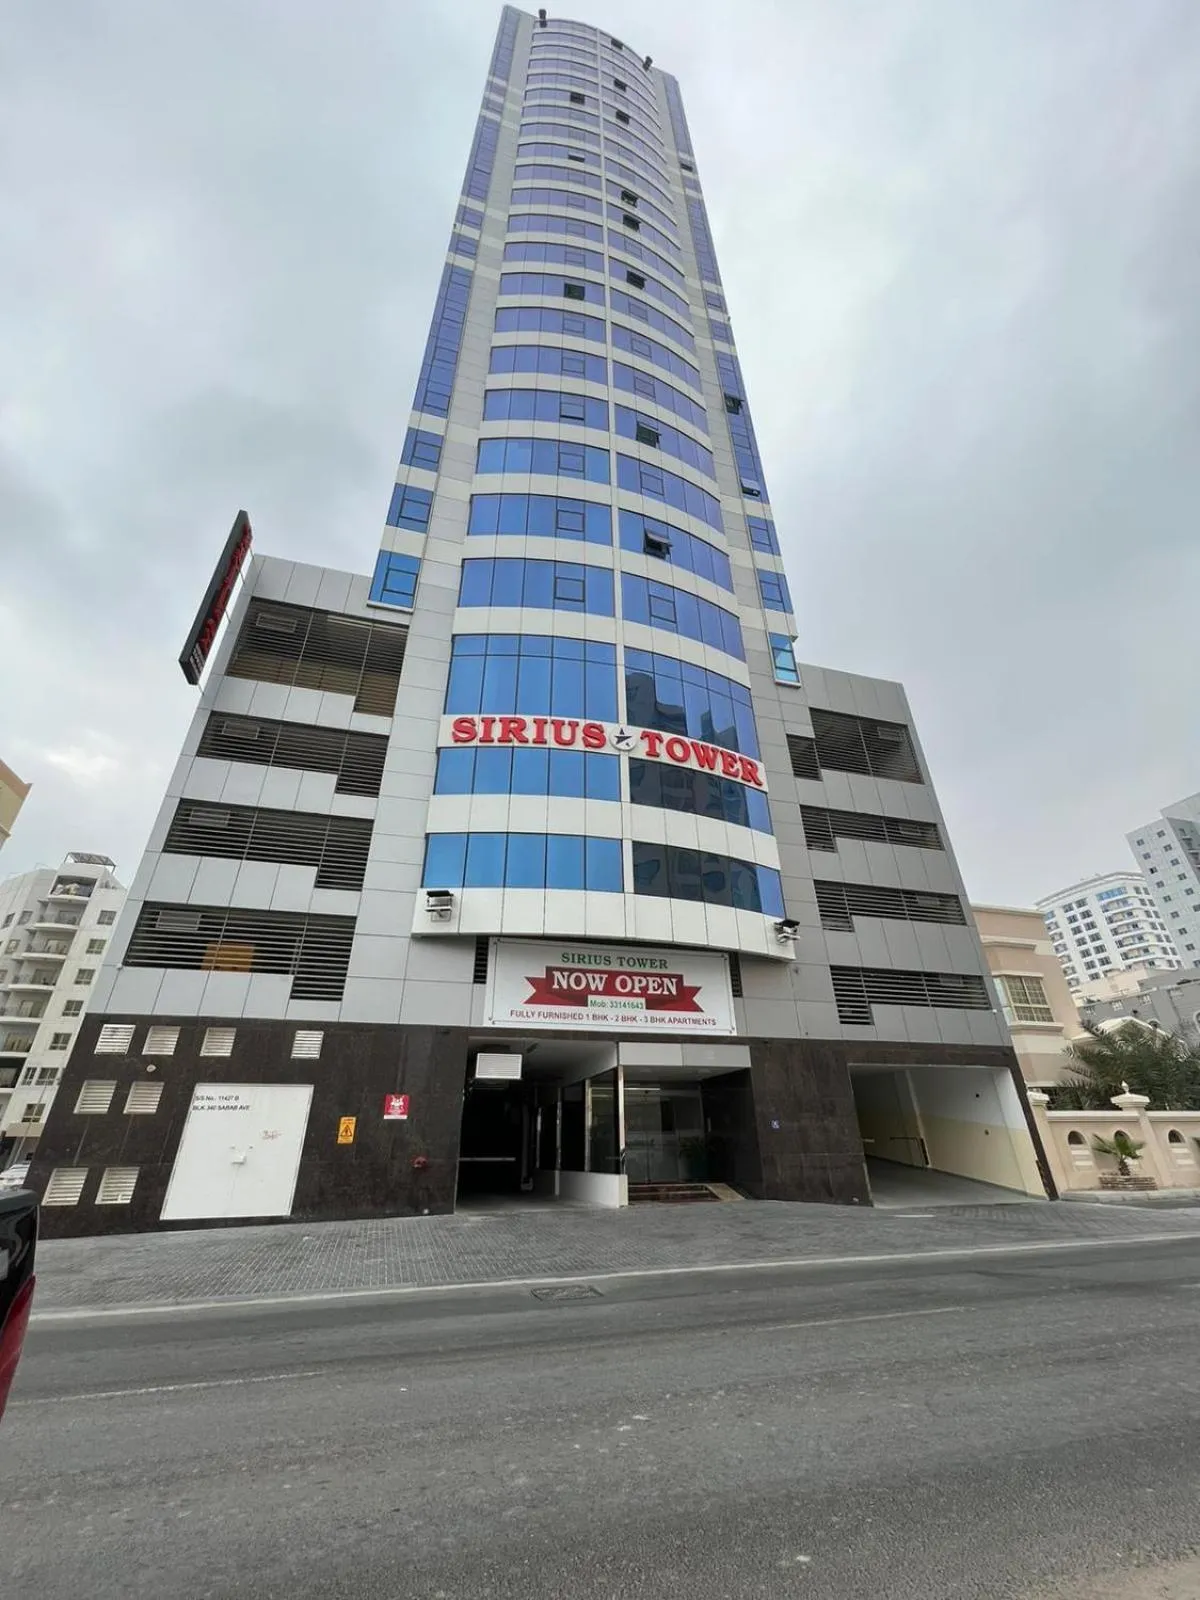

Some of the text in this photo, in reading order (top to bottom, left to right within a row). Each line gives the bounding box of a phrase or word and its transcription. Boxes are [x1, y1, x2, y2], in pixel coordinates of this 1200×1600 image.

[452, 717, 763, 787] SIRIUS TOWER
[561, 952, 668, 970] SIRIUS TOWER
[552, 971, 678, 996] NOW OPEN
[590, 999, 608, 1009] Mob:
[510, 1009, 536, 1018] FULLY
[538, 1011, 584, 1020] FURNISHED
[592, 1013, 609, 1021] BHK
[621, 1014, 638, 1022] BHK
[644, 1015, 649, 1023] 3
[650, 1015, 666, 1024] BHK
[667, 1016, 717, 1026] APARTMENTS
